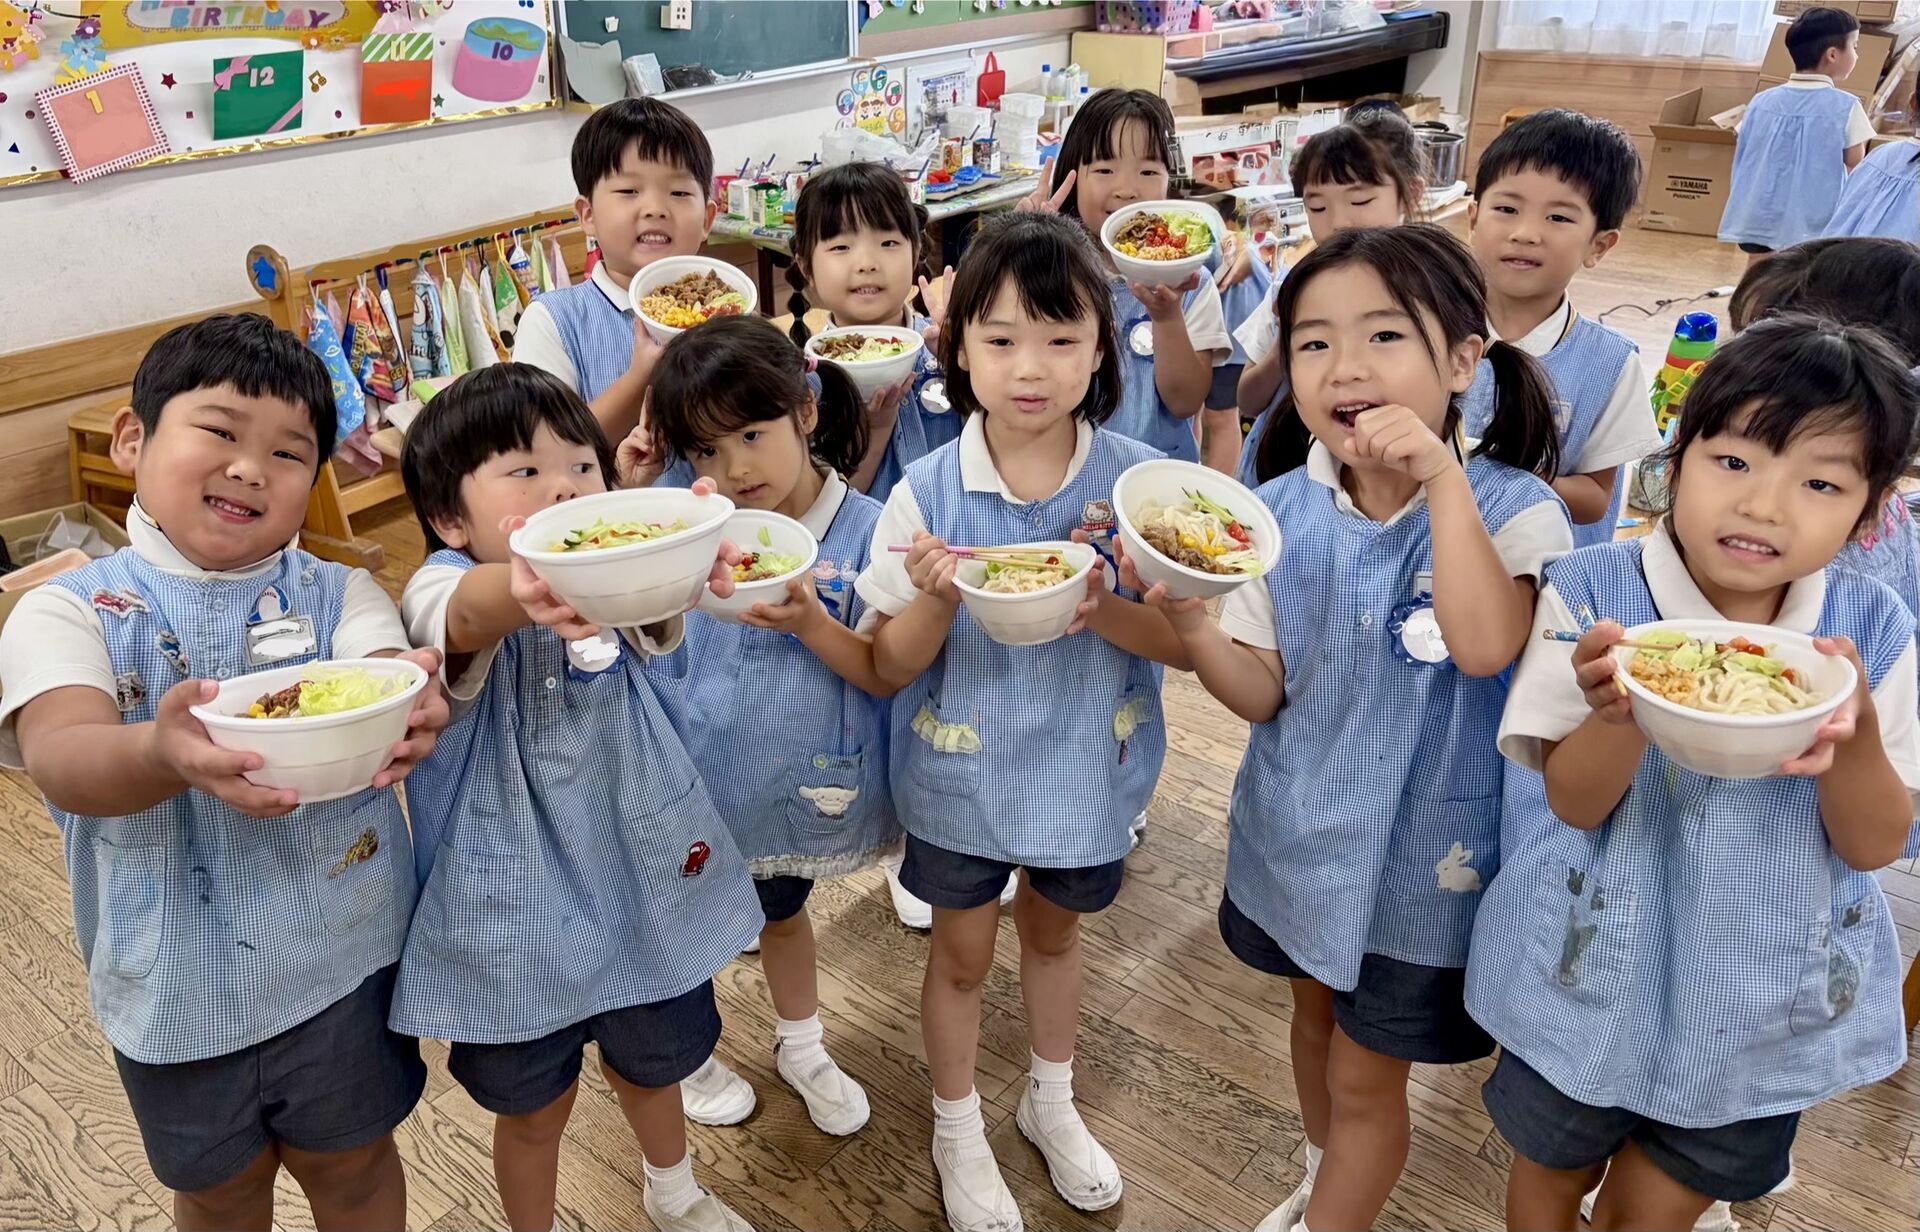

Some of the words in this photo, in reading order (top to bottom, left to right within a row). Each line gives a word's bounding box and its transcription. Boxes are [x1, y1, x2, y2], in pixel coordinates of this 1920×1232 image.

[170, 6, 330, 28] BIRTHDAY
[491, 41, 514, 61] 10
[249, 66, 275, 88] 12
[84, 90, 104, 115] 1
[1680, 180, 1708, 190] YAMAHA
